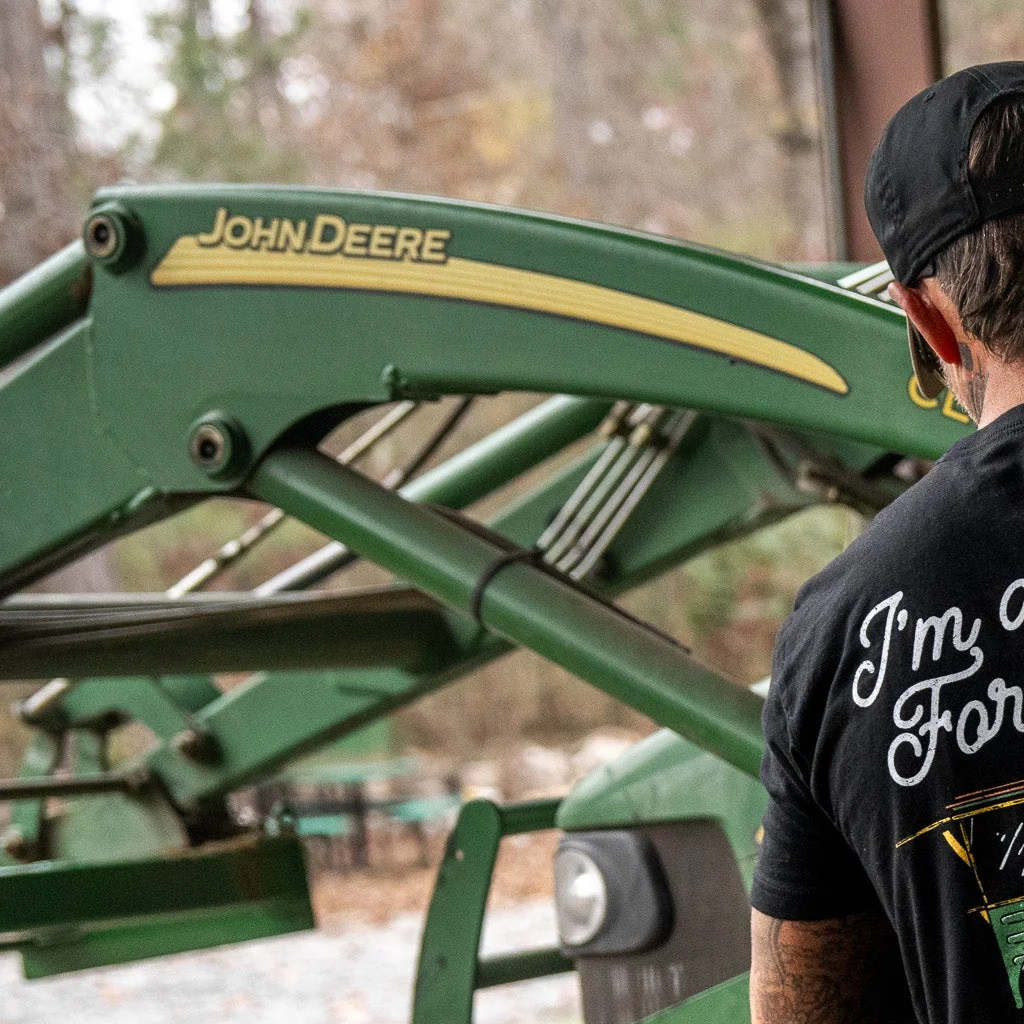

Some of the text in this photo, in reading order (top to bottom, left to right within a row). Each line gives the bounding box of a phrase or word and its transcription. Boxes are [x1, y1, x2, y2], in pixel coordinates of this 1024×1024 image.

[198, 207, 450, 264] JOHN DEERE
[852, 590, 982, 708] I'm
